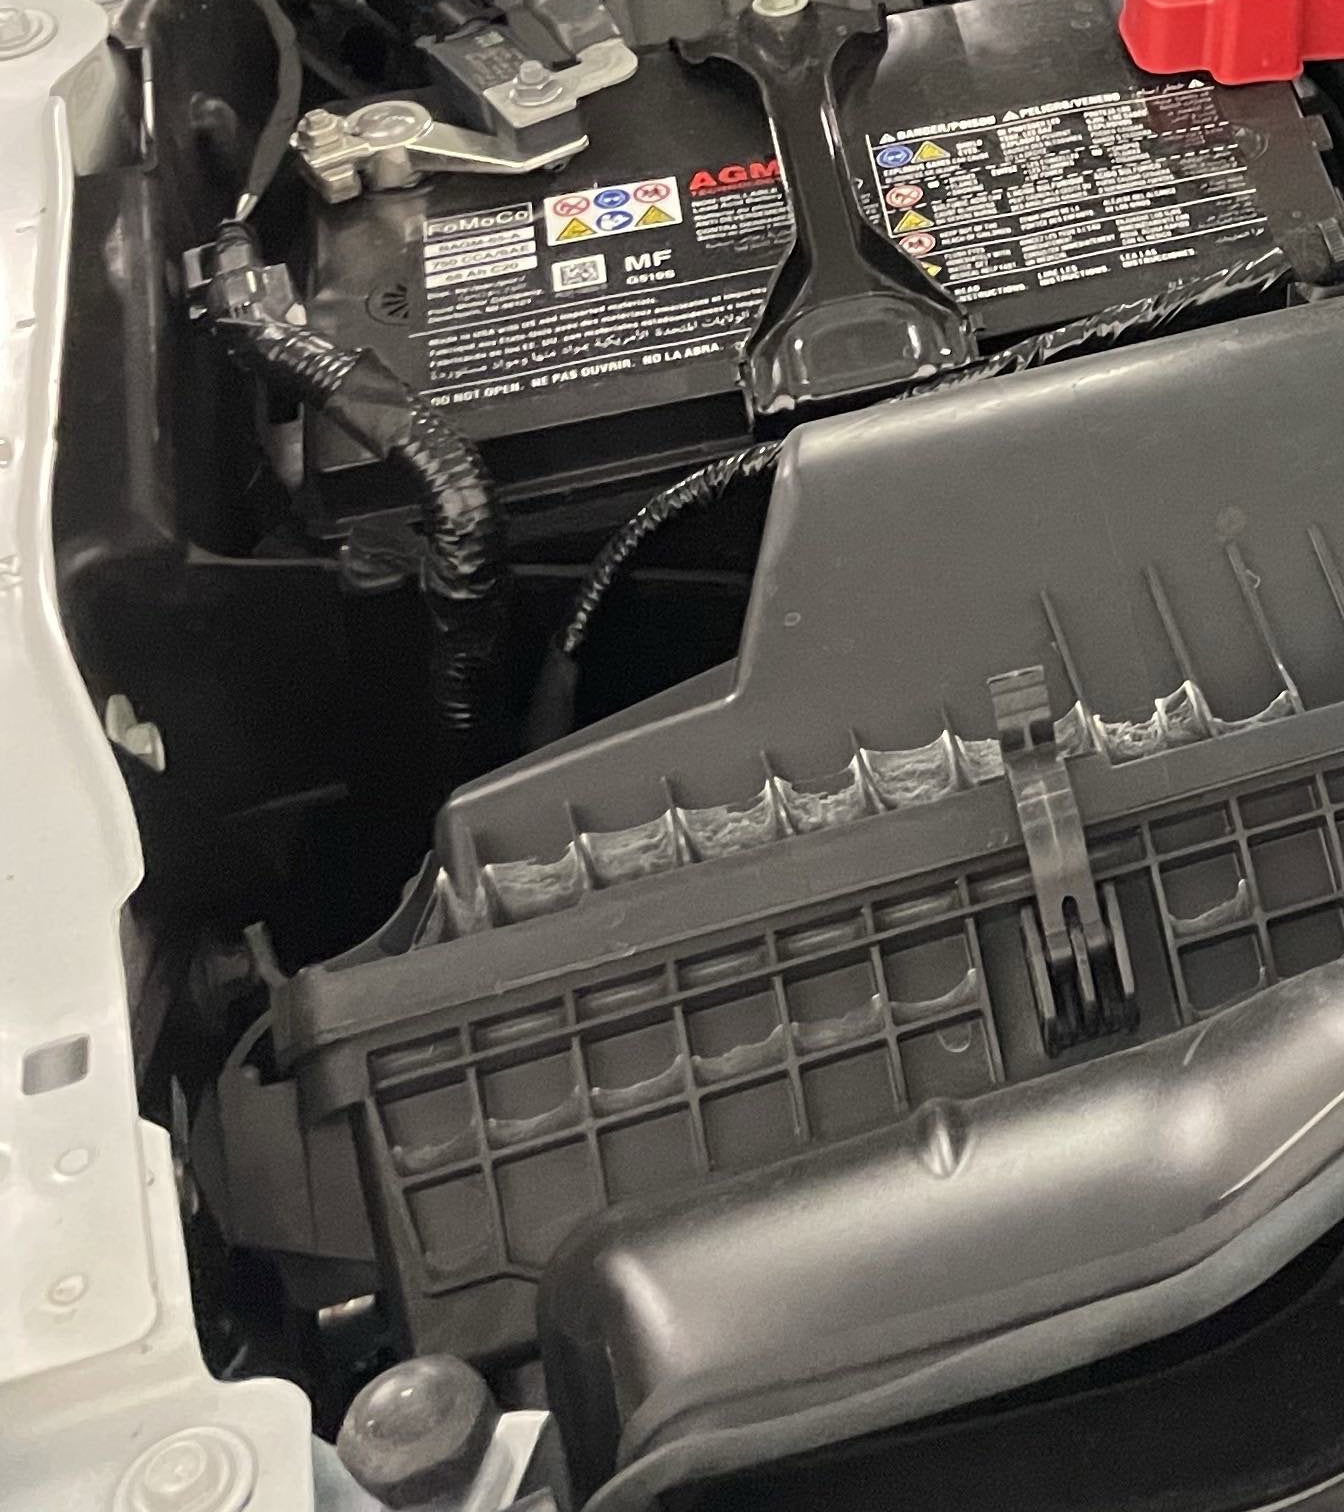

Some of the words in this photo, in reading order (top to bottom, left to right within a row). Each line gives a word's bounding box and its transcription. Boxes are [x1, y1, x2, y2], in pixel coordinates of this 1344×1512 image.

[689, 160, 778, 189] AGM
[425, 206, 530, 237] FoMoCo
[622, 247, 674, 272] MF
